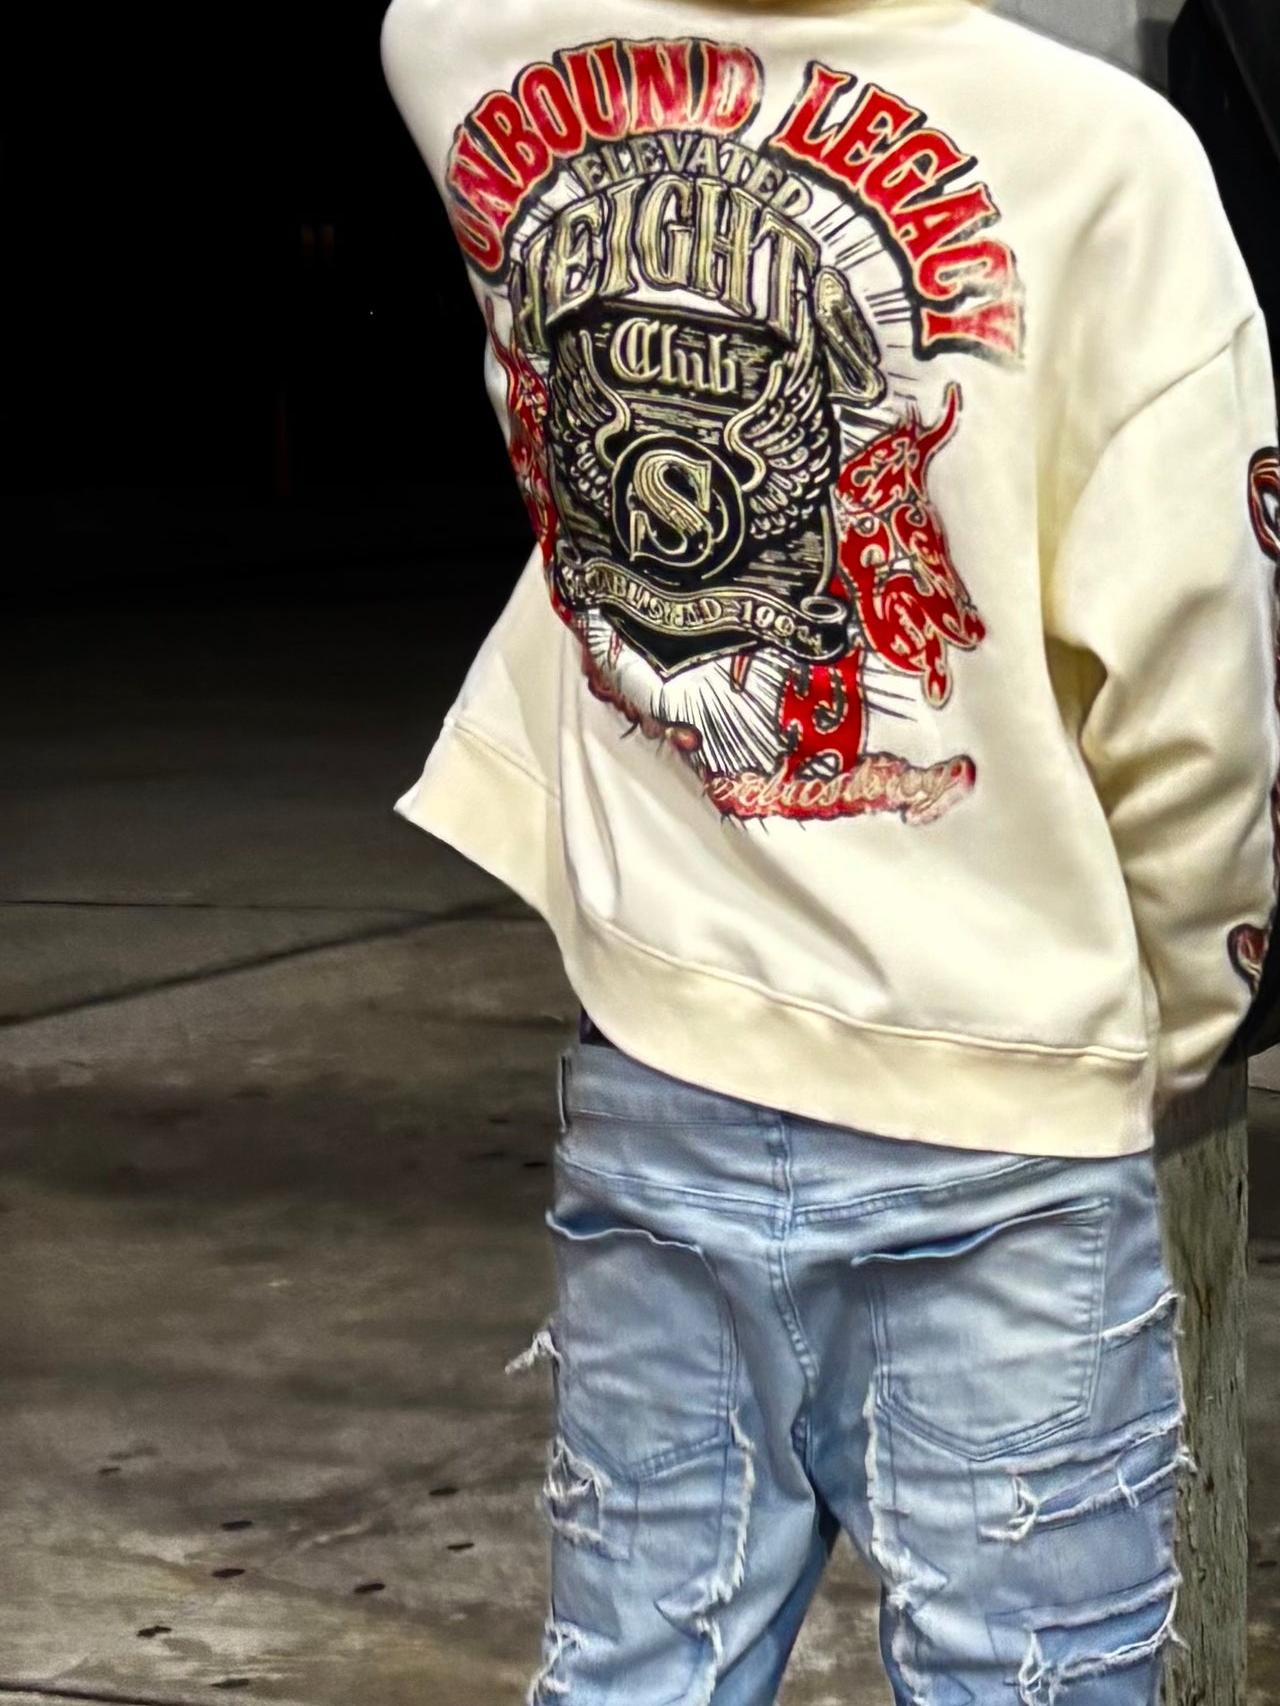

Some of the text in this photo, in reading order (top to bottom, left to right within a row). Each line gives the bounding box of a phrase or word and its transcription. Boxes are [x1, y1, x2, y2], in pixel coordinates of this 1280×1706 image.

[447, 38, 1025, 363] UNBOUND LEGACY
[570, 131, 814, 218] ELEVATED
[609, 315, 738, 395] Club
